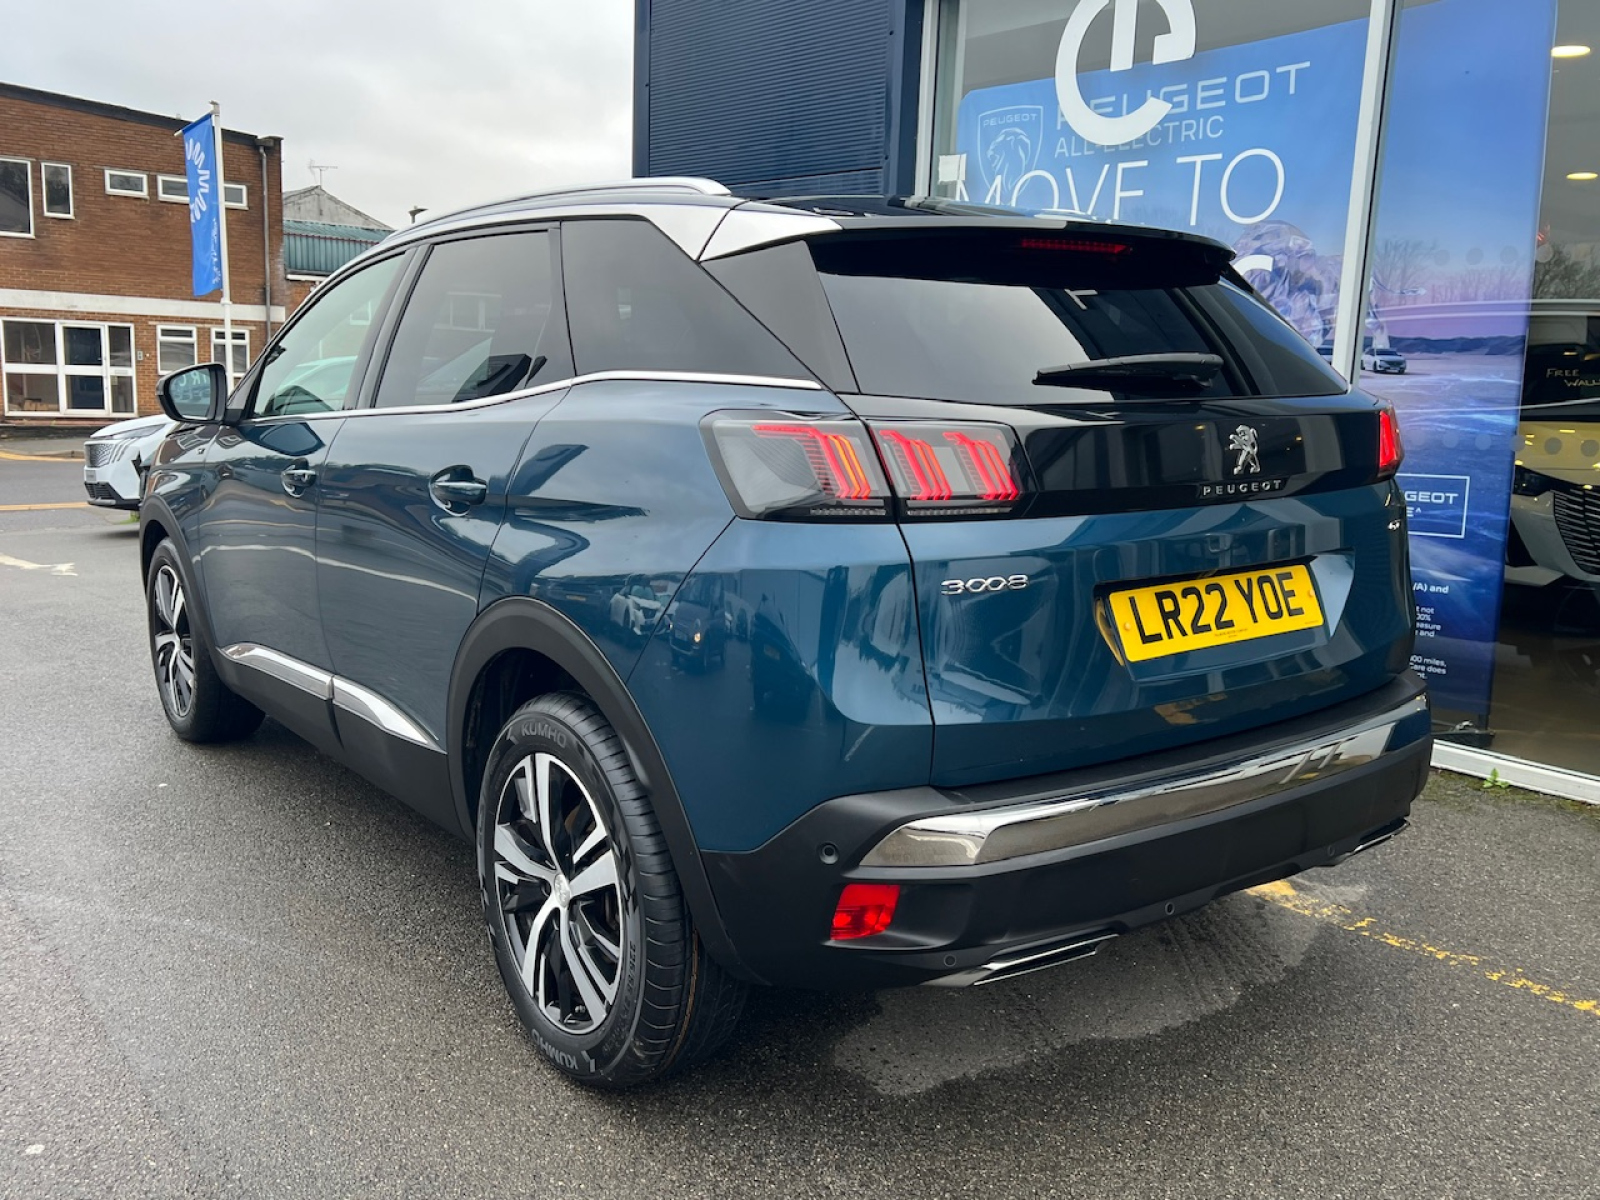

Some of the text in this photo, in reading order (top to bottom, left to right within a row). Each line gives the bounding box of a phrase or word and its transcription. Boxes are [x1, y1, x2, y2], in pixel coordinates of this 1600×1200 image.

[983, 112, 1038, 127] PEUGEOT
[1176, 148, 1285, 227] TO
[1546, 368, 1580, 378] FREE
[1564, 378, 1600, 387] WALL
[1203, 479, 1281, 496] PEUGEOT
[941, 574, 1029, 595] 3008
[1429, 585, 1449, 593] and
[1128, 571, 1305, 645] LR22 YOE
[520, 721, 567, 749] KUMHO
[531, 1028, 579, 1070] KUMHO
